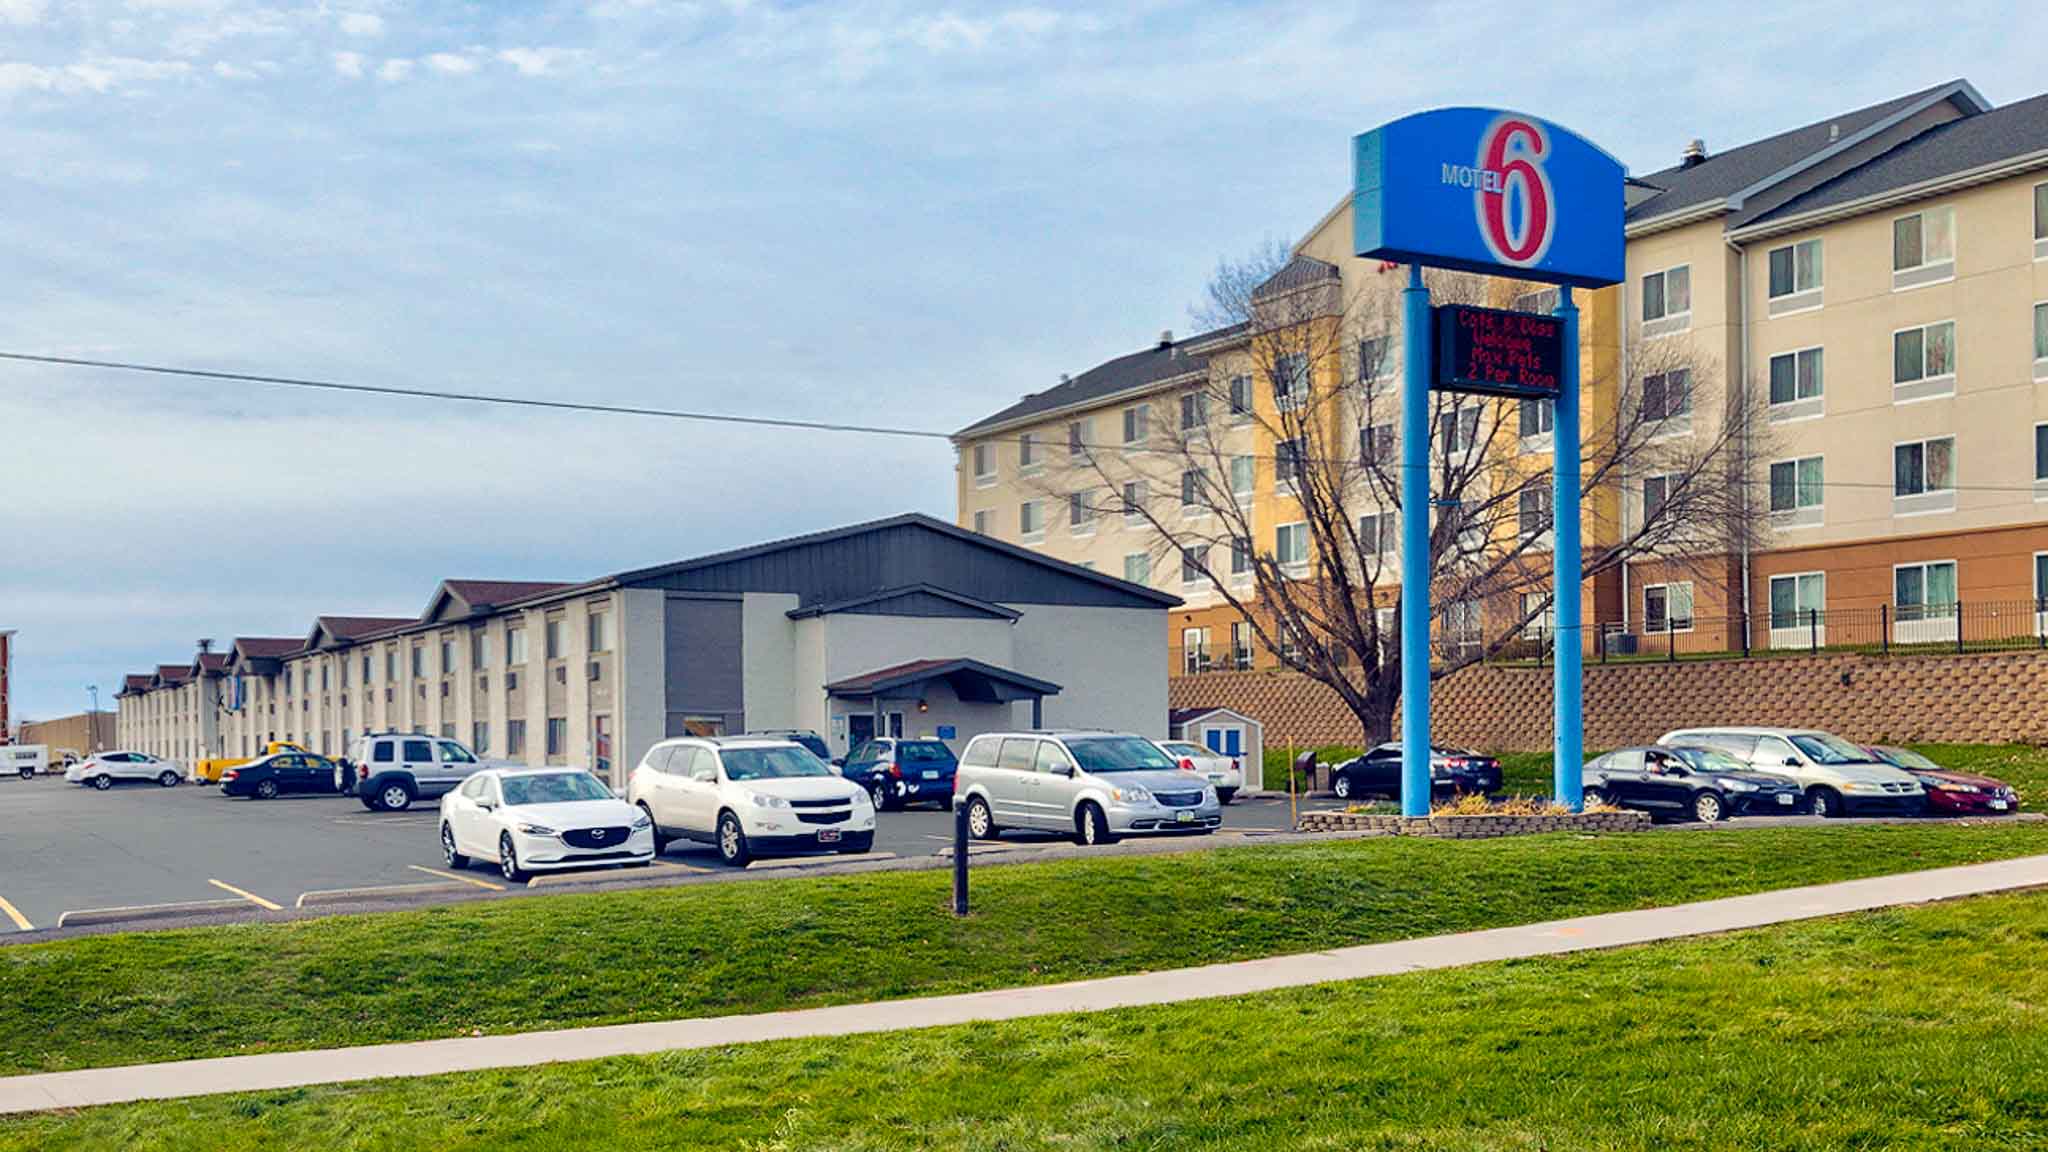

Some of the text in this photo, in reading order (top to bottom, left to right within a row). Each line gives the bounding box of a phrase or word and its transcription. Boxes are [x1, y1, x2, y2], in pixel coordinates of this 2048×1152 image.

[1442, 115, 1552, 265] MOTEL 6
[1471, 348, 1540, 369] Max Pets
[1467, 362, 1556, 387] 2 Per Room
